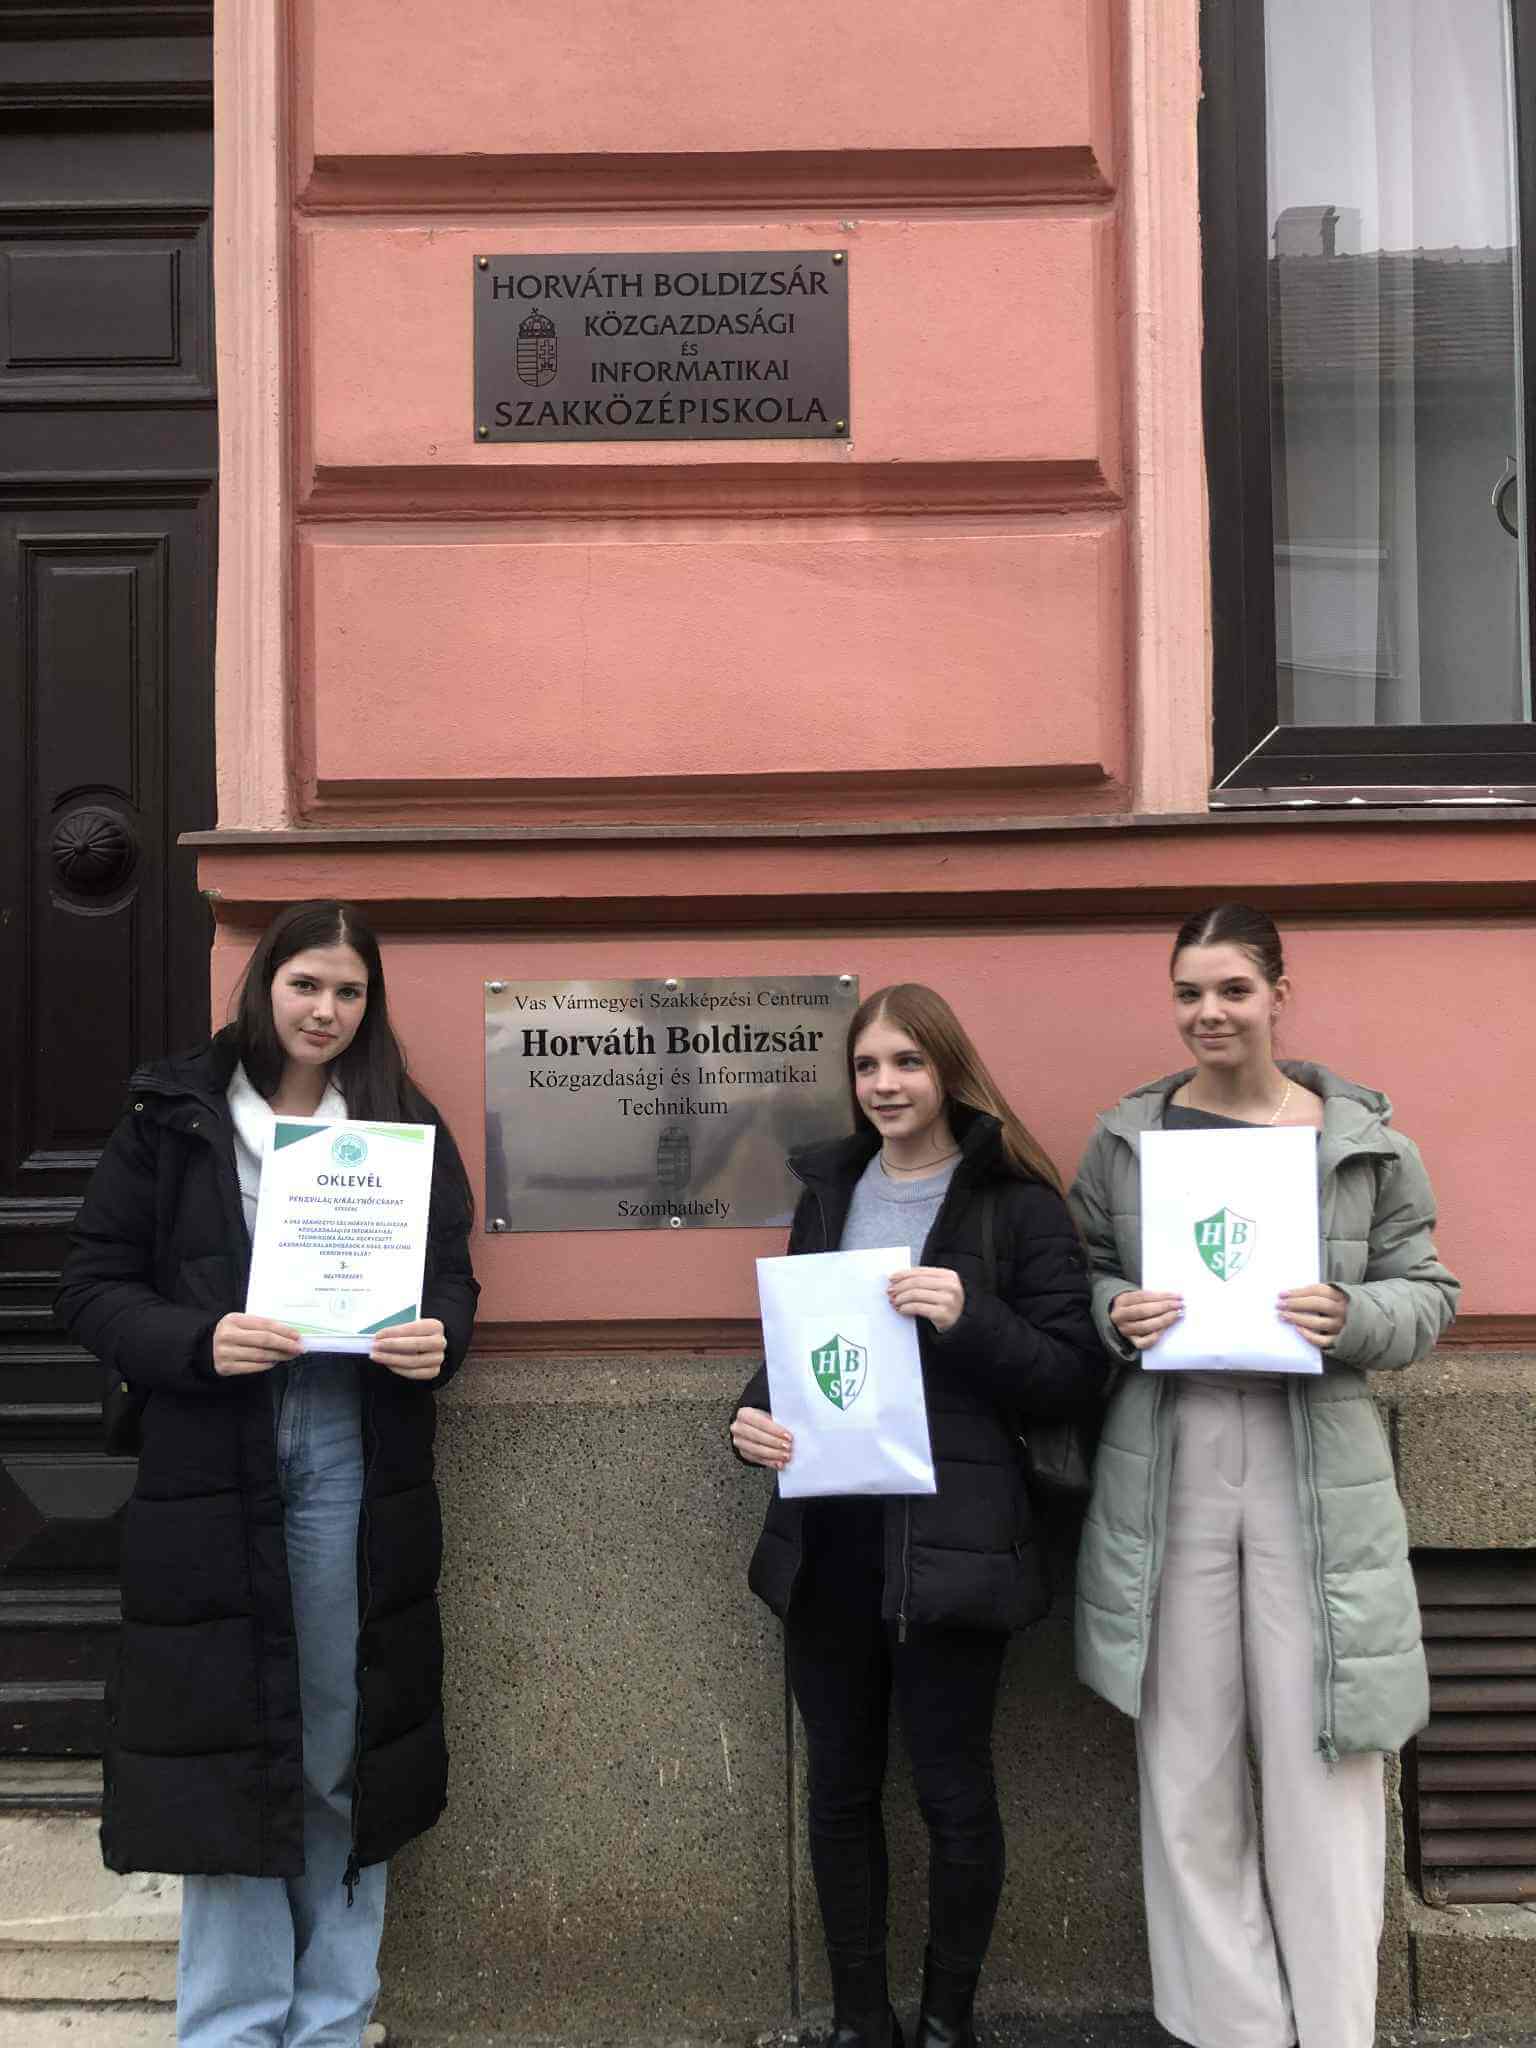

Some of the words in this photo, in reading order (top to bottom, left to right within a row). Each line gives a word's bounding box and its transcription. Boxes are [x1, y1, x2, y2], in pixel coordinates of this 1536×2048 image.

[492, 267, 642, 299] HORVÁTH
[654, 264, 829, 296] BOLDIZSÁR
[584, 307, 795, 336] KÖZGAZDASÁGI
[681, 341, 699, 356] ÉS
[591, 359, 789, 383] INFORMATIKAI
[494, 392, 828, 427] SZAKKÖZÉPISKOLA
[514, 995, 547, 1011] Vas
[552, 993, 644, 1013] Vármegyei
[650, 991, 751, 1010] Szakképzési
[757, 991, 829, 1006] Centrum
[521, 1026, 656, 1057] Horváth
[666, 1025, 824, 1054] Boldizsár
[528, 1067, 664, 1092] Közgazdasági
[671, 1067, 691, 1085] és
[698, 1064, 817, 1084] Informatikai
[618, 1097, 729, 1116] Technikum
[317, 1173, 382, 1188] OKLEVÉL
[618, 1198, 731, 1219] Szombathely
